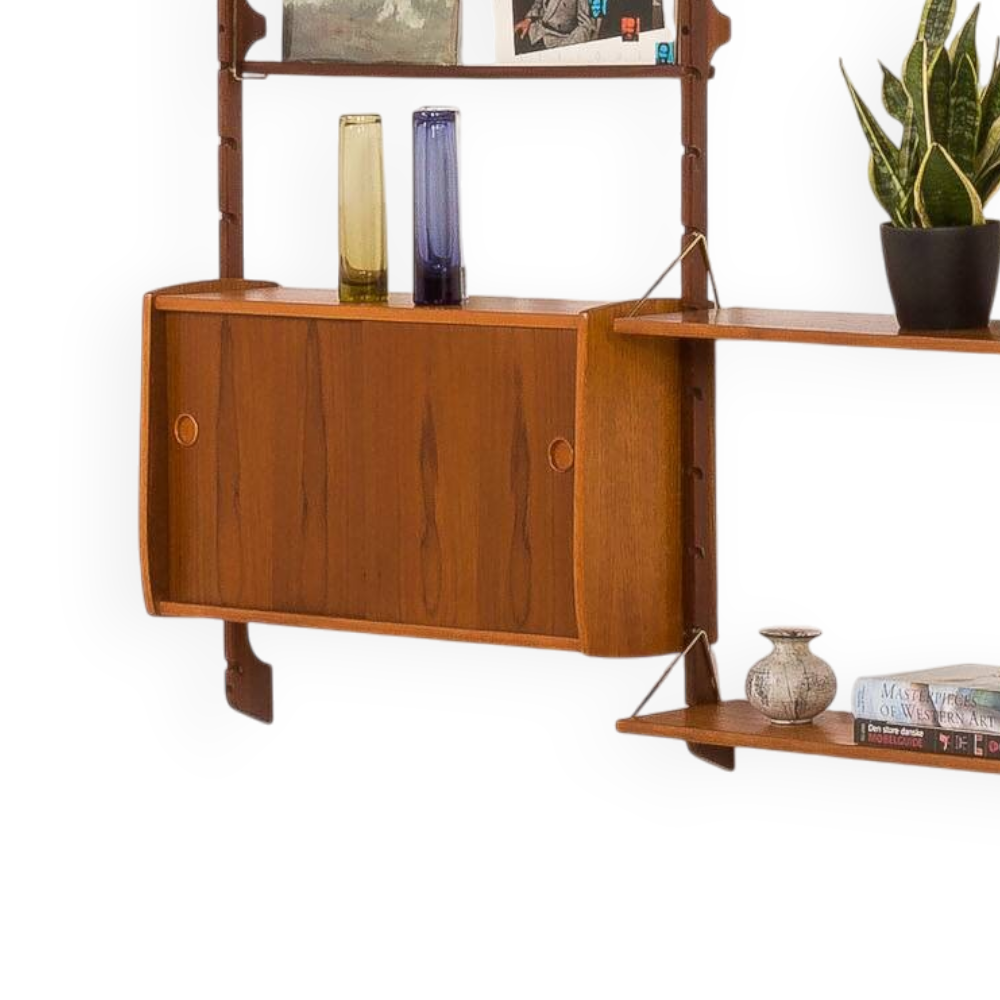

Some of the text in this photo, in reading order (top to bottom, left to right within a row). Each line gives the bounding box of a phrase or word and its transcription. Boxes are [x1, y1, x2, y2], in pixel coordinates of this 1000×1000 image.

[881, 682, 977, 709] MASTERPIECES
[900, 704, 965, 726] WESTERN
[970, 710, 995, 728] ART
[868, 724, 882, 733] Den
[900, 727, 925, 738] danske
